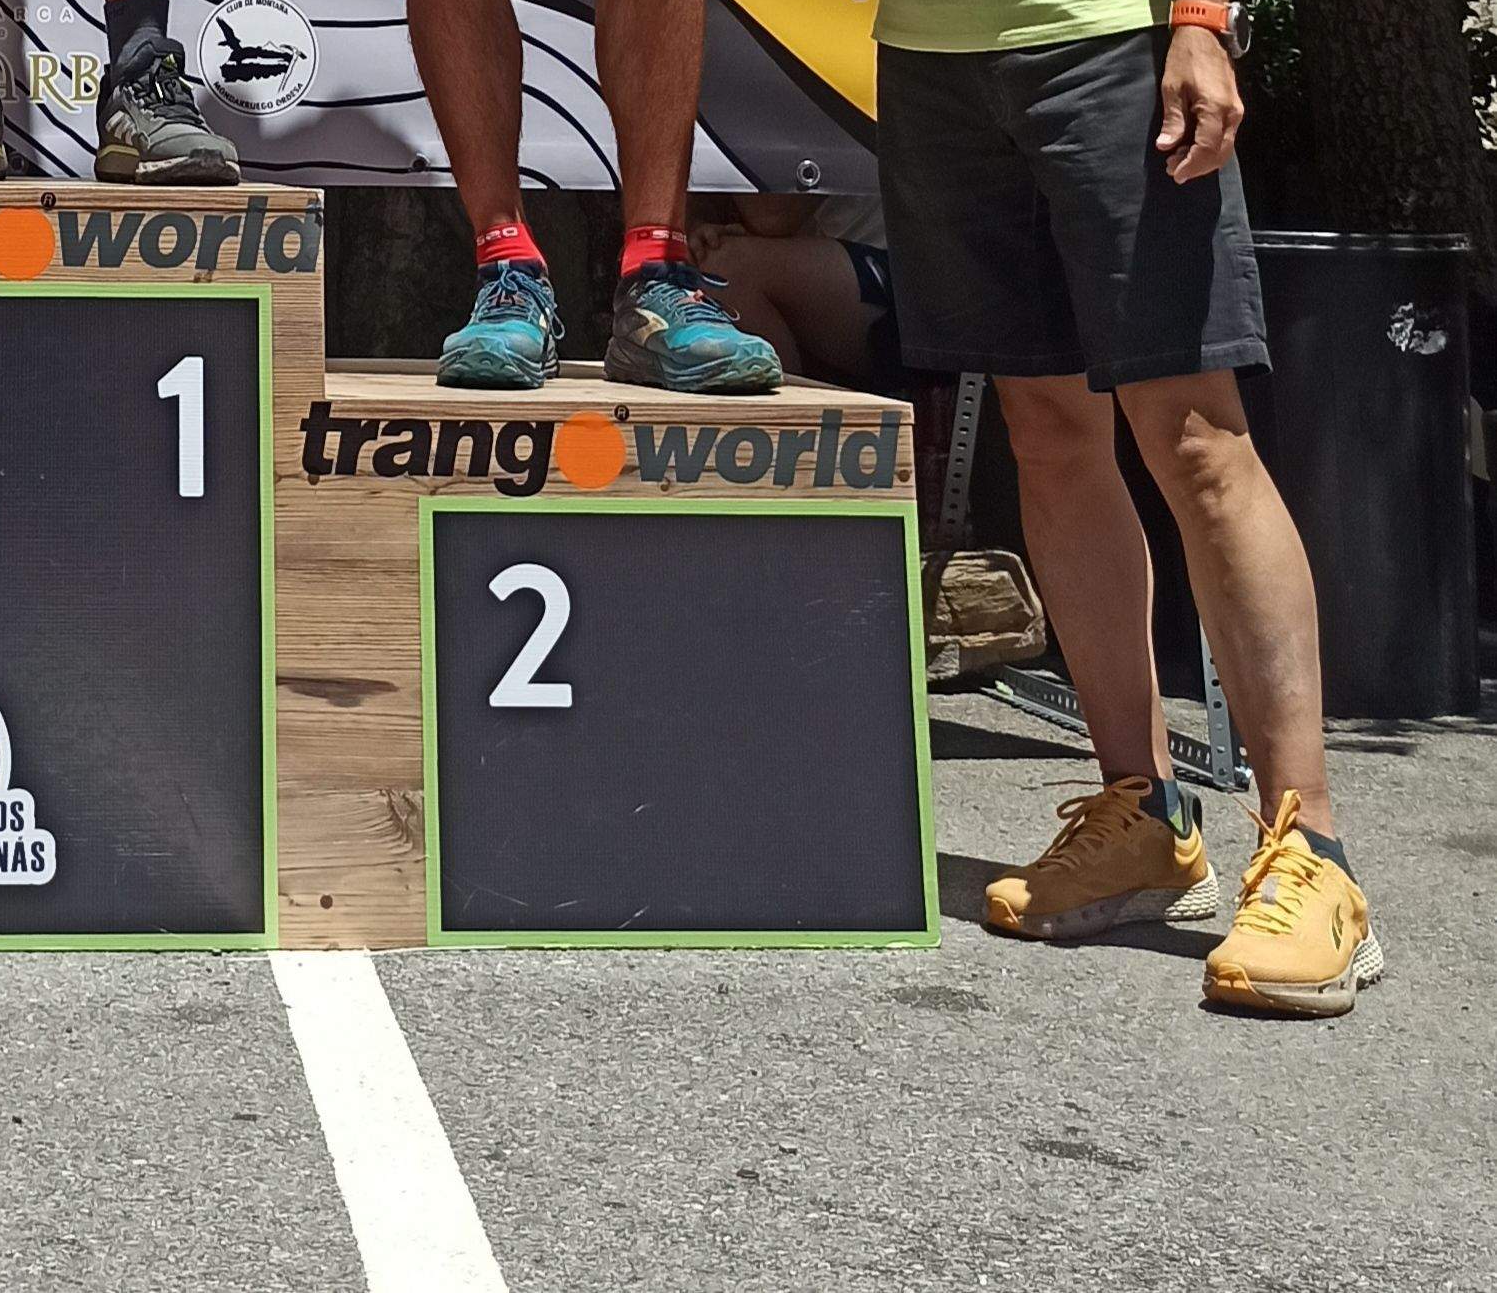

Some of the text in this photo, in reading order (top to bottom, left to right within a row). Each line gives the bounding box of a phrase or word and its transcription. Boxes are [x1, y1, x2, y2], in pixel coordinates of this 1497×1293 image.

[226, 0, 244, 14] CLUB
[213, 81, 303, 110] MONDARRUEGO ORDESA
[157, 356, 204, 497] 1
[300, 401, 903, 498] trangoworld
[488, 563, 573, 708] 2
